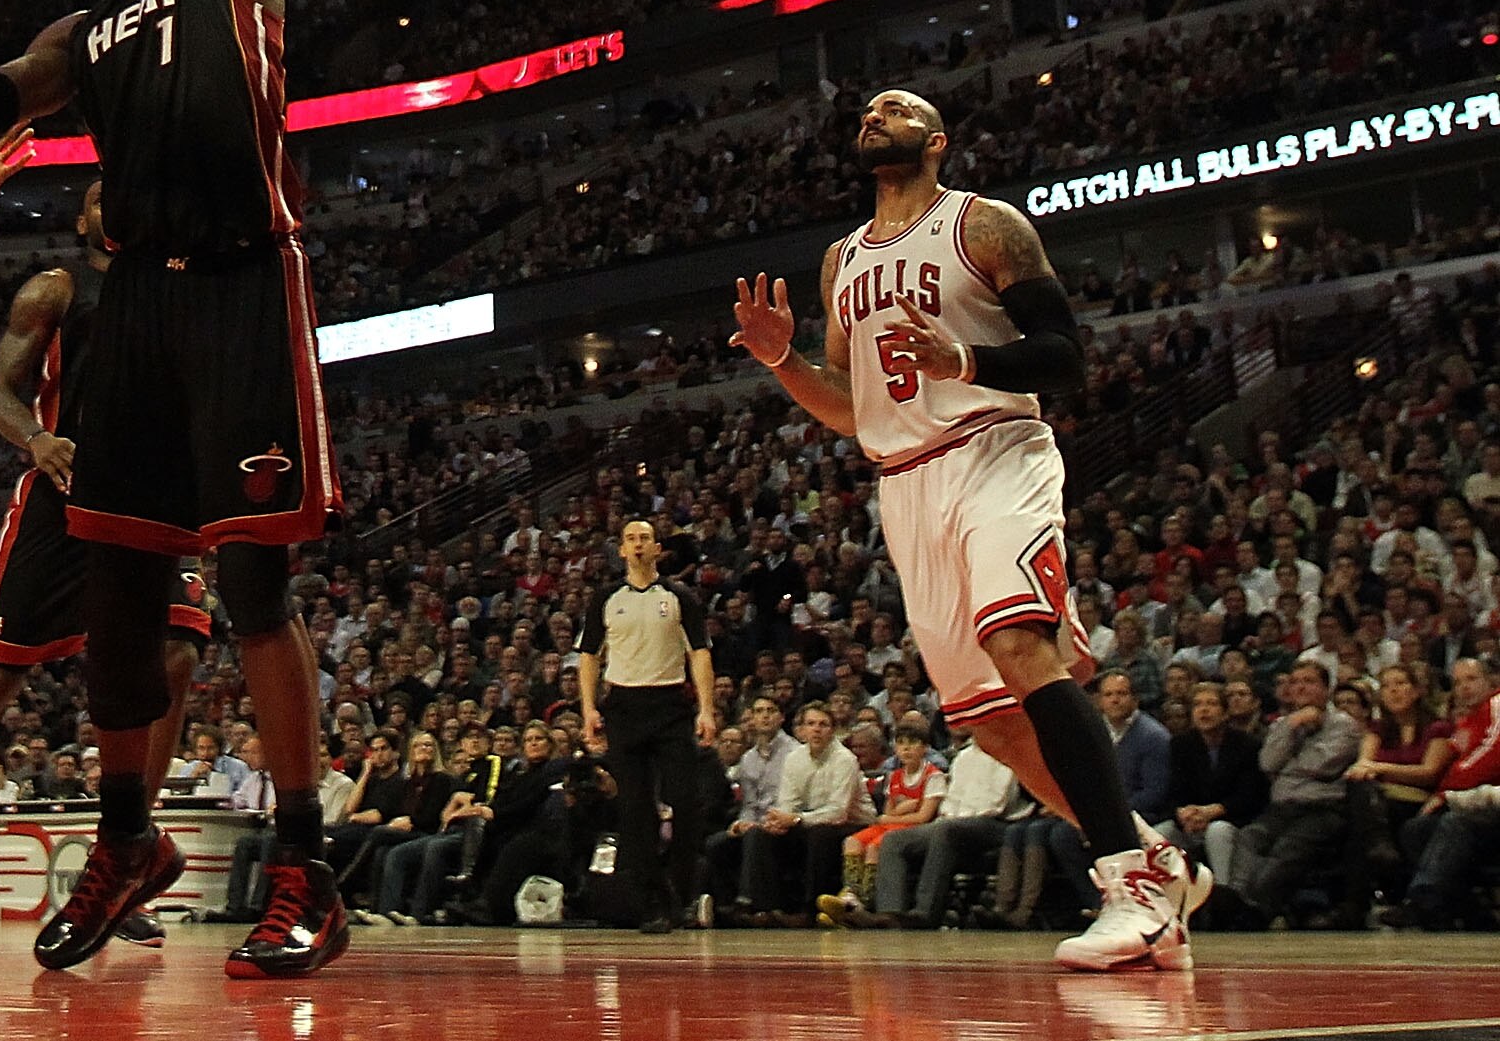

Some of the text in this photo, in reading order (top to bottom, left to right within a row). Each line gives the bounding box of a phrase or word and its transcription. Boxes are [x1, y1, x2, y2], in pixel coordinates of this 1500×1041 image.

[156, 16, 173, 66] 1
[555, 29, 625, 72] LET'S
[1026, 168, 1129, 217] CATCH
[1134, 158, 1196, 197] ALL
[1196, 134, 1301, 184] BULLS
[838, 259, 941, 338] BULLS
[876, 331, 920, 403] 5
